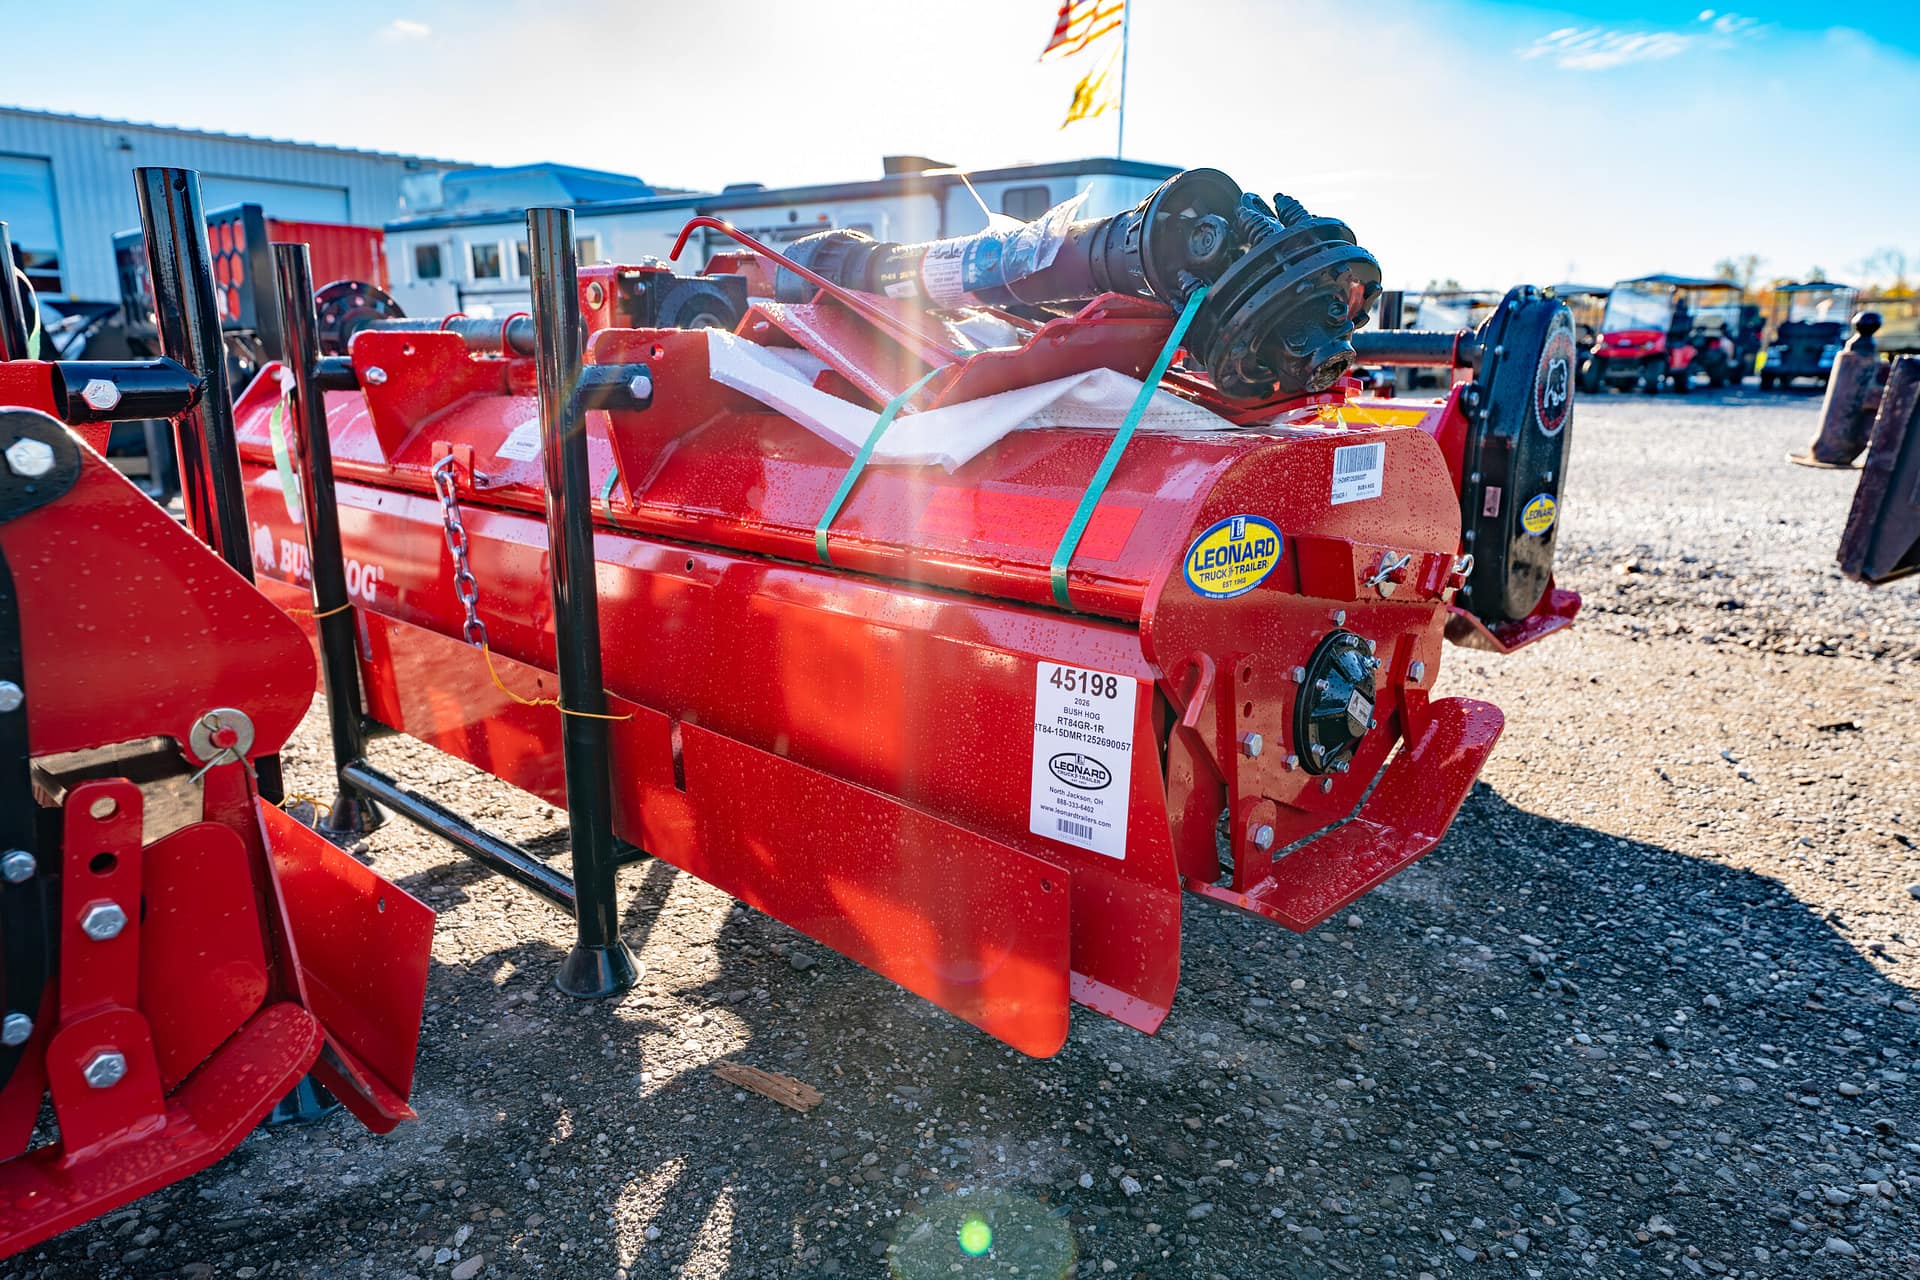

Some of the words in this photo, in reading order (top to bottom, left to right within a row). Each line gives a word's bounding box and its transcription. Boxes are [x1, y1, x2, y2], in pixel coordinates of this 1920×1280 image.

[280, 538, 311, 580] BUS
[1194, 537, 1275, 571] LEONARD
[1199, 569, 1227, 583] TRUCK
[1234, 560, 1267, 575] TRAILER
[1050, 667, 1117, 699] 45198
[1074, 697, 1090, 707] 2026
[1063, 706, 1083, 717] BUSH
[1085, 710, 1100, 720] HOG
[1057, 716, 1104, 734] RT84GR-1R
[1054, 760, 1106, 780] LEONARD
[1050, 786, 1065, 795] North
[1066, 791, 1093, 803] Jackson,
[1094, 798, 1104, 806] OH
[1040, 804, 1112, 828] www.leonardtrailers.com
